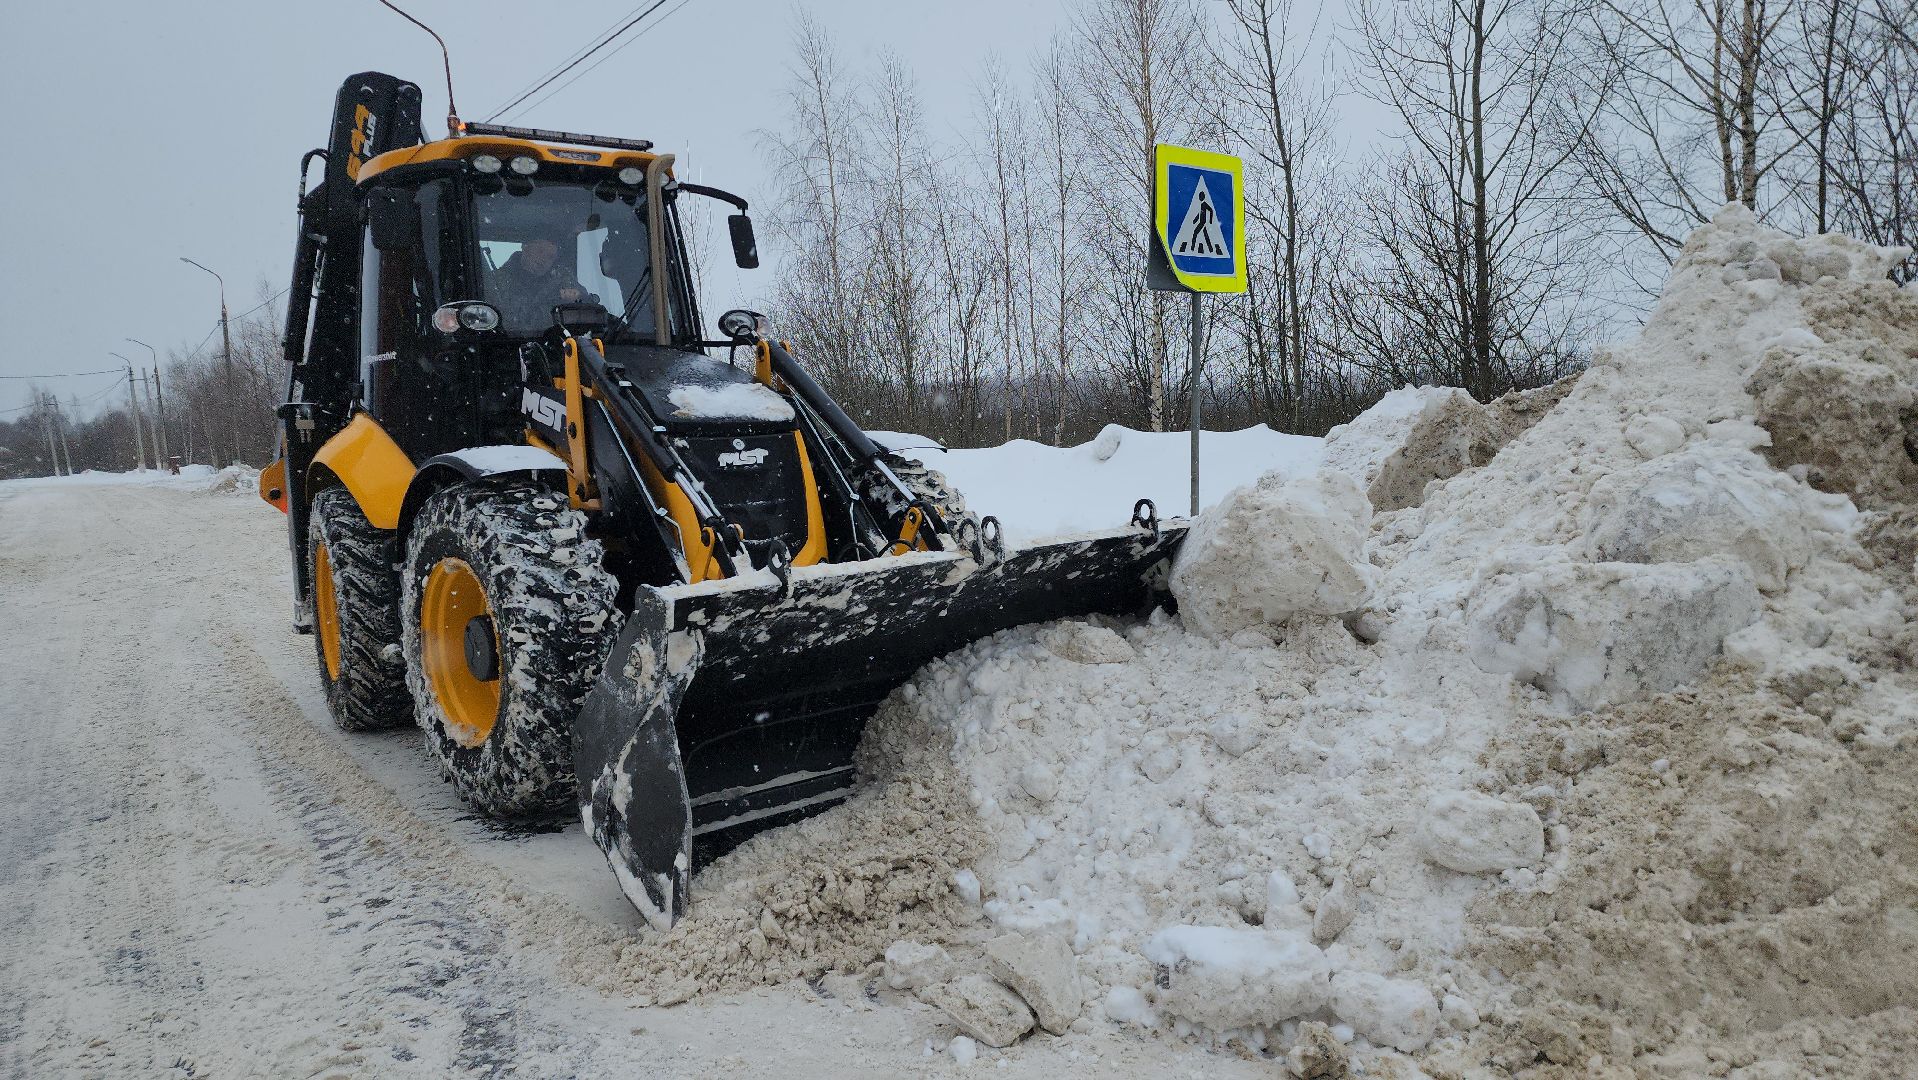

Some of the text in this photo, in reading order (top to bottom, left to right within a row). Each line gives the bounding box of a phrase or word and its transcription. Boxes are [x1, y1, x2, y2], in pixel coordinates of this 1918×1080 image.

[362, 112, 377, 158] PLUS
[520, 386, 567, 433] MST
[717, 447, 769, 467] MST
